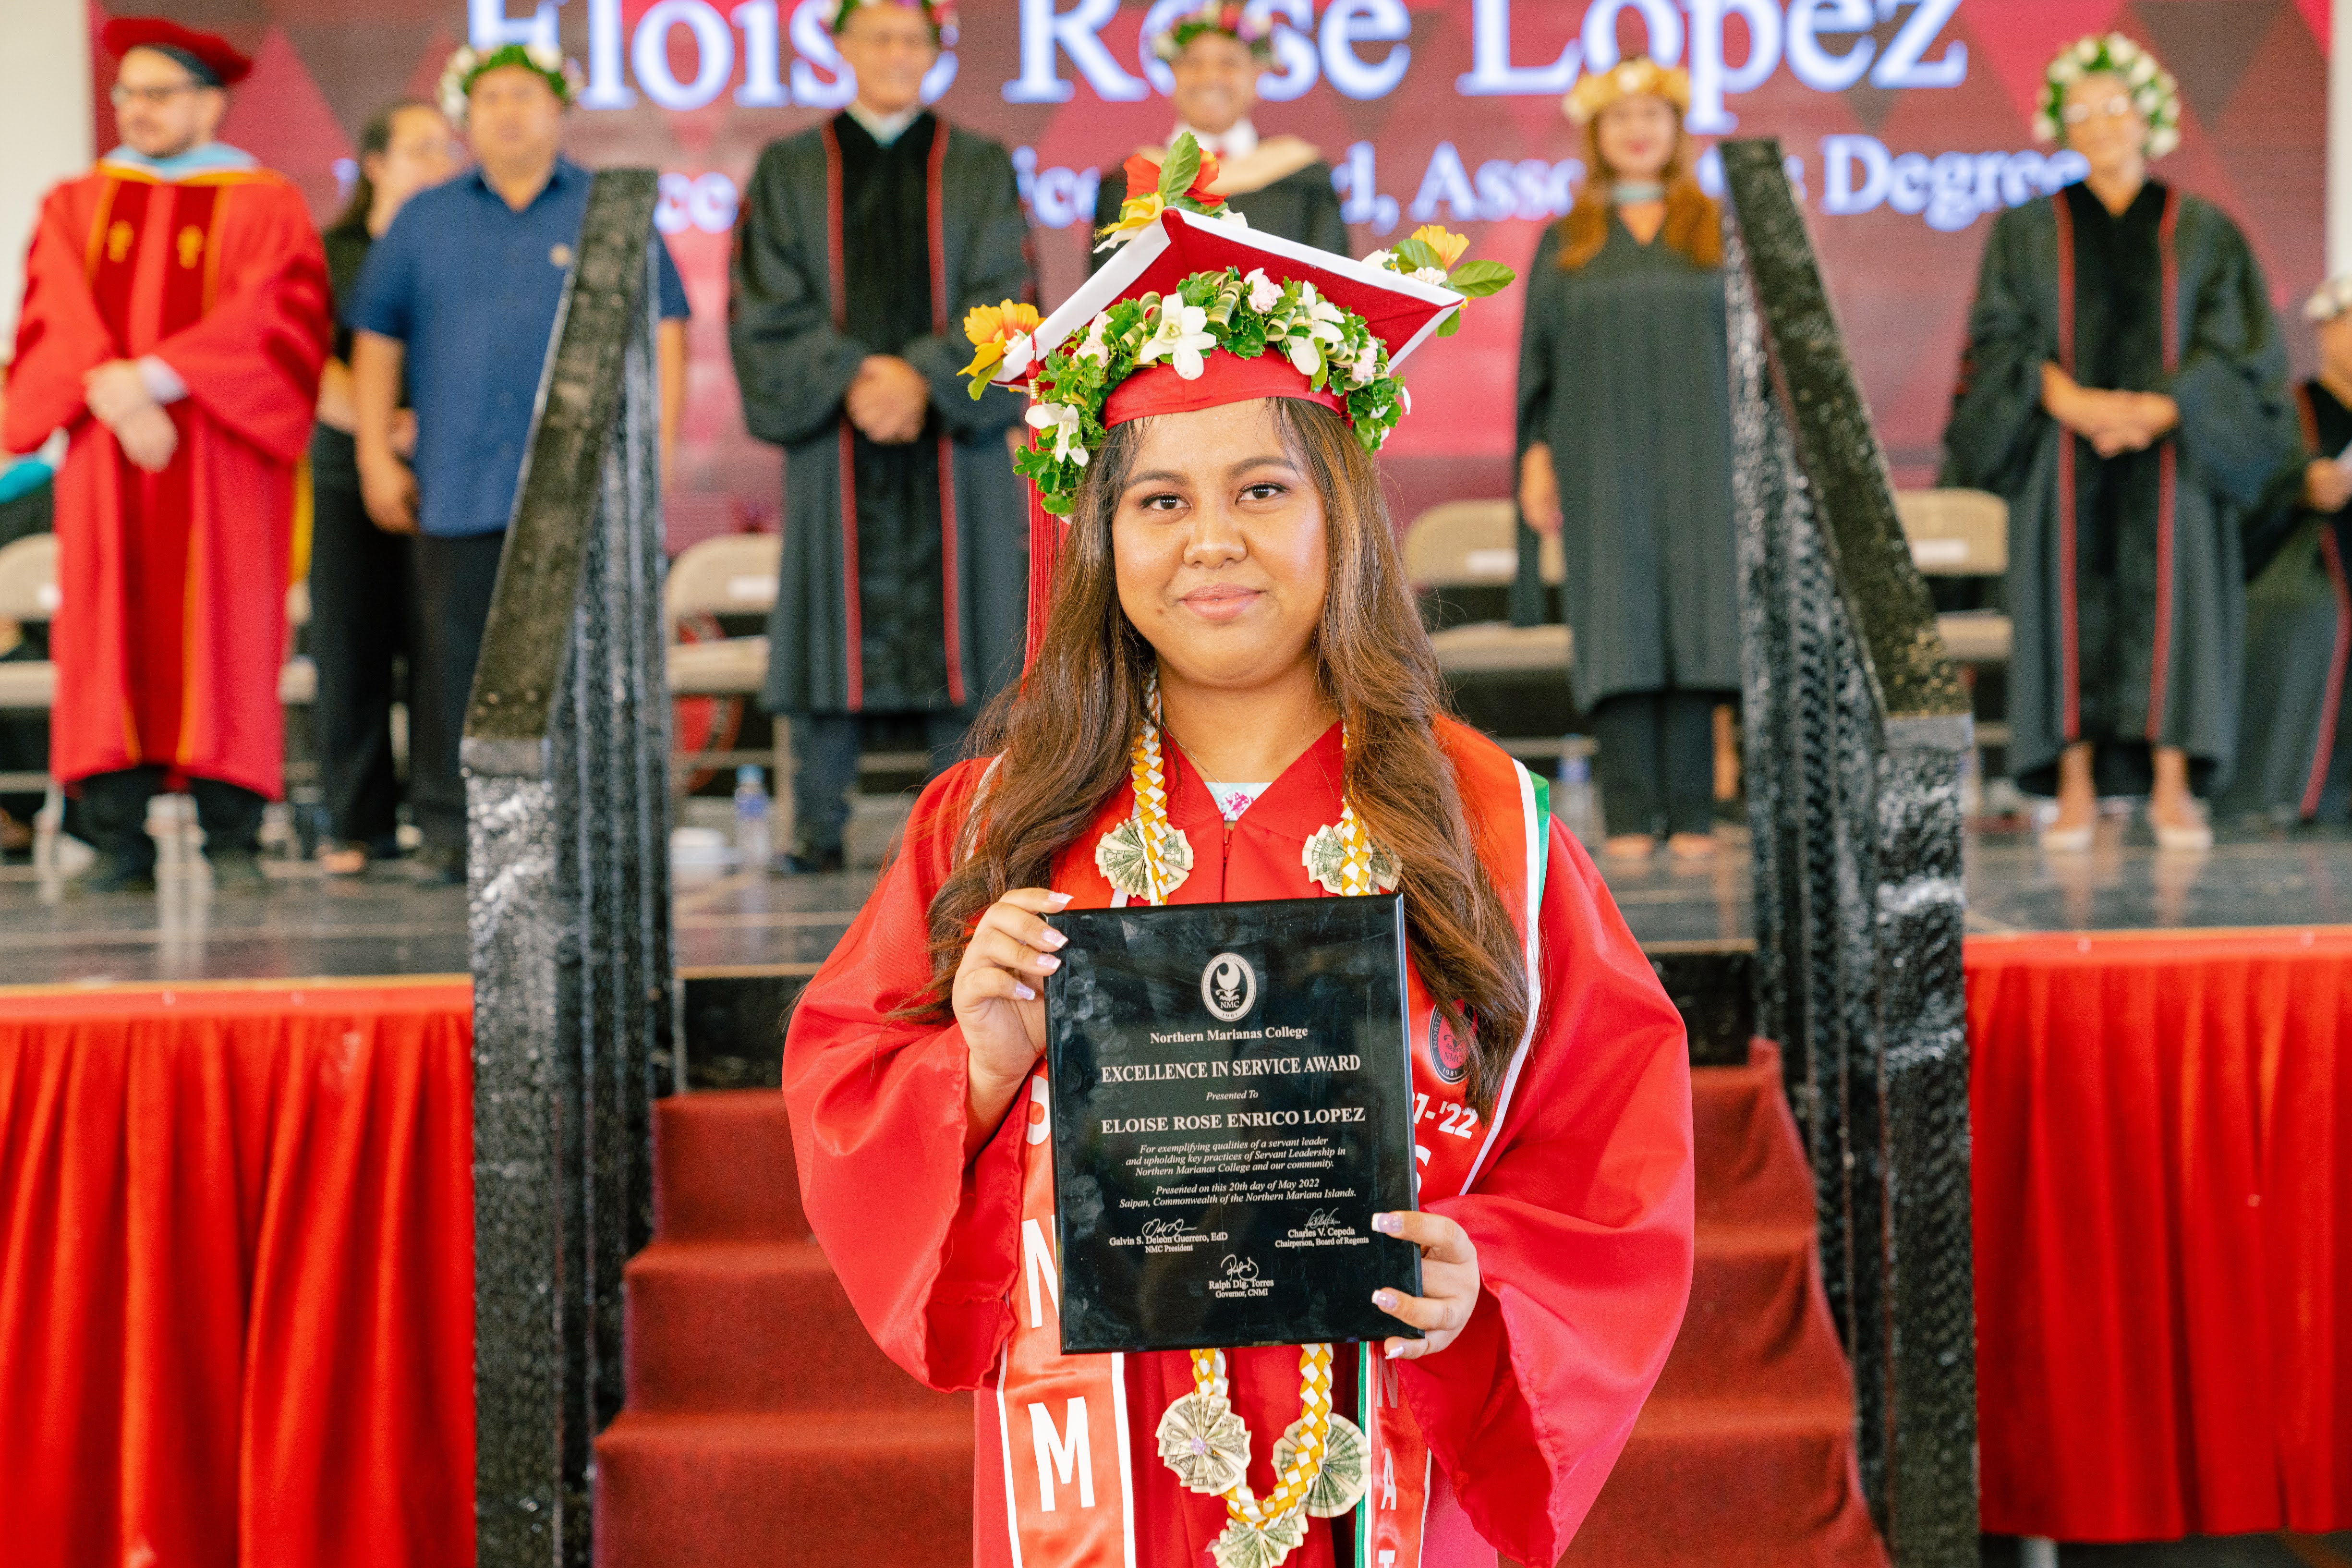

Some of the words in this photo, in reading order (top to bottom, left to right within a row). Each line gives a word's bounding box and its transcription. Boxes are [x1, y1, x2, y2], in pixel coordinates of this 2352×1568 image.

[1454, 0, 1968, 135] Lopez
[1205, 963, 1216, 1002] NORTHERN
[1216, 956, 1248, 972] MARIANAS
[1150, 1032, 1203, 1044] Northern
[1207, 1029, 1262, 1041] Marianas
[1265, 1026, 1308, 1039] College
[1444, 1052, 1463, 1064] NMC
[1101, 1061, 1208, 1083] EXCELLENCE
[1211, 1061, 1228, 1078] IN
[1232, 1057, 1301, 1076] SERVICE
[1304, 1055, 1361, 1073] AWARD
[1443, 1068, 1457, 1077] 1981
[1206, 1090, 1247, 1101] Presented
[1249, 1090, 1259, 1099] To
[1101, 1117, 1168, 1134] ELOISE
[1173, 1114, 1222, 1130] ROSE
[1226, 1111, 1299, 1128] ENRICO
[1303, 1107, 1366, 1124] LOPEZ
[1412, 1092, 1478, 1139] 1-'22
[1140, 1144, 1156, 1154] For
[1158, 1143, 1210, 1154] exemplifying
[1212, 1141, 1248, 1152] qualities
[1250, 1139, 1261, 1150] of
[1269, 1139, 1299, 1147] servant
[1302, 1136, 1328, 1145] leader
[1126, 1156, 1142, 1166] and
[1144, 1155, 1186, 1166] upholding
[1188, 1154, 1202, 1164] key
[1203, 1153, 1242, 1164] practices
[1244, 1151, 1254, 1162] of
[1254, 1150, 1287, 1160] Servant
[1288, 1147, 1335, 1158] Leadership
[1337, 1147, 1346, 1155] in
[1135, 1166, 1173, 1176] Northern
[1176, 1165, 1215, 1175] Marianas
[1218, 1162, 1250, 1174] College
[1252, 1161, 1269, 1171] and
[1287, 1159, 1334, 1169] community.
[1156, 1184, 1198, 1195] Presented
[1212, 1183, 1227, 1191] this
[1229, 1181, 1248, 1191] 20th
[1250, 1181, 1265, 1191] day
[1267, 1180, 1277, 1191] of
[1278, 1179, 1297, 1191] May
[1298, 1178, 1320, 1188] 2022
[1119, 1199, 1150, 1210] Saipan,
[1153, 1194, 1217, 1207] Commonwealth
[1220, 1194, 1230, 1205] of
[1231, 1192, 1243, 1203] the
[1246, 1192, 1284, 1202] Northern
[1286, 1190, 1322, 1200] Mariana
[1324, 1188, 1357, 1198] Islands.
[1109, 1237, 1135, 1246] Galvin
[1136, 1236, 1144, 1245] S.
[1146, 1235, 1172, 1244] Deleon
[1174, 1234, 1209, 1243] Guerrero,
[1211, 1232, 1228, 1241] EdD
[1288, 1228, 1316, 1238] Charles
[1317, 1228, 1326, 1237] V.
[1327, 1226, 1355, 1238] Cepeda
[1164, 1244, 1193, 1252] President
[1275, 1240, 1314, 1249] Chairperson,
[1345, 1237, 1369, 1246] Regents
[1209, 1280, 1231, 1290] Ralph
[1233, 1279, 1249, 1290] Dlg.
[1250, 1279, 1274, 1287] Torres
[1215, 1290, 1247, 1298] Governor,
[1248, 1288, 1268, 1296] CNMI
